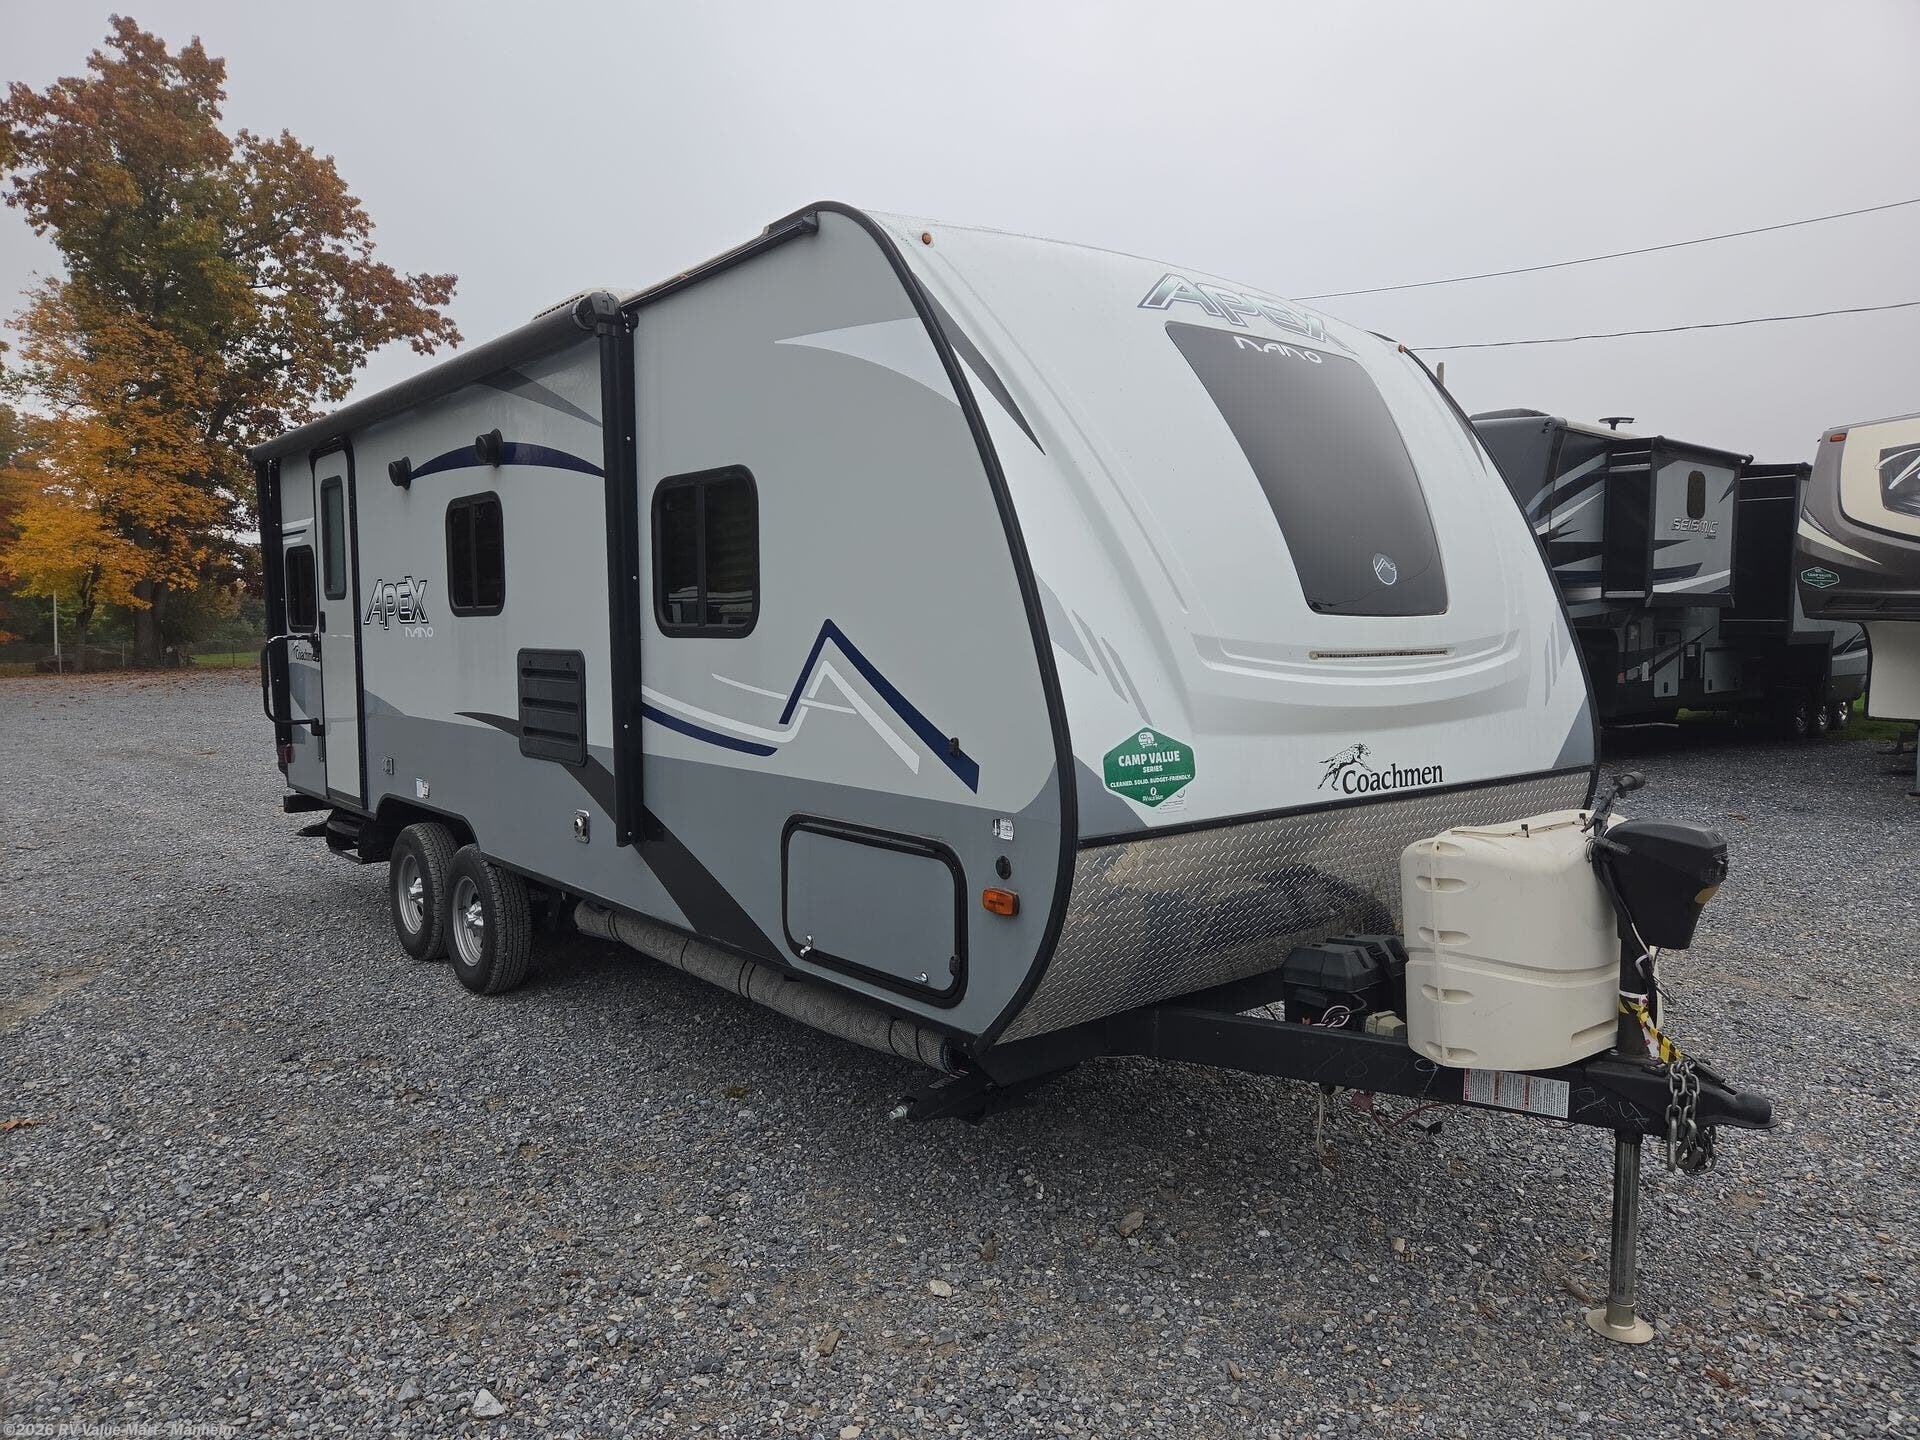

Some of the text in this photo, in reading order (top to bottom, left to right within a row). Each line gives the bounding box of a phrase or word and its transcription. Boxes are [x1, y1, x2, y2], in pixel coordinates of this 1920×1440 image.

[1137, 273, 1352, 353] APEX
[363, 576, 429, 630] APEX
[1118, 751, 1181, 767] CAMP VALUE
[1142, 765, 1163, 774] SERIES
[1342, 763, 1444, 795] Coachmen
